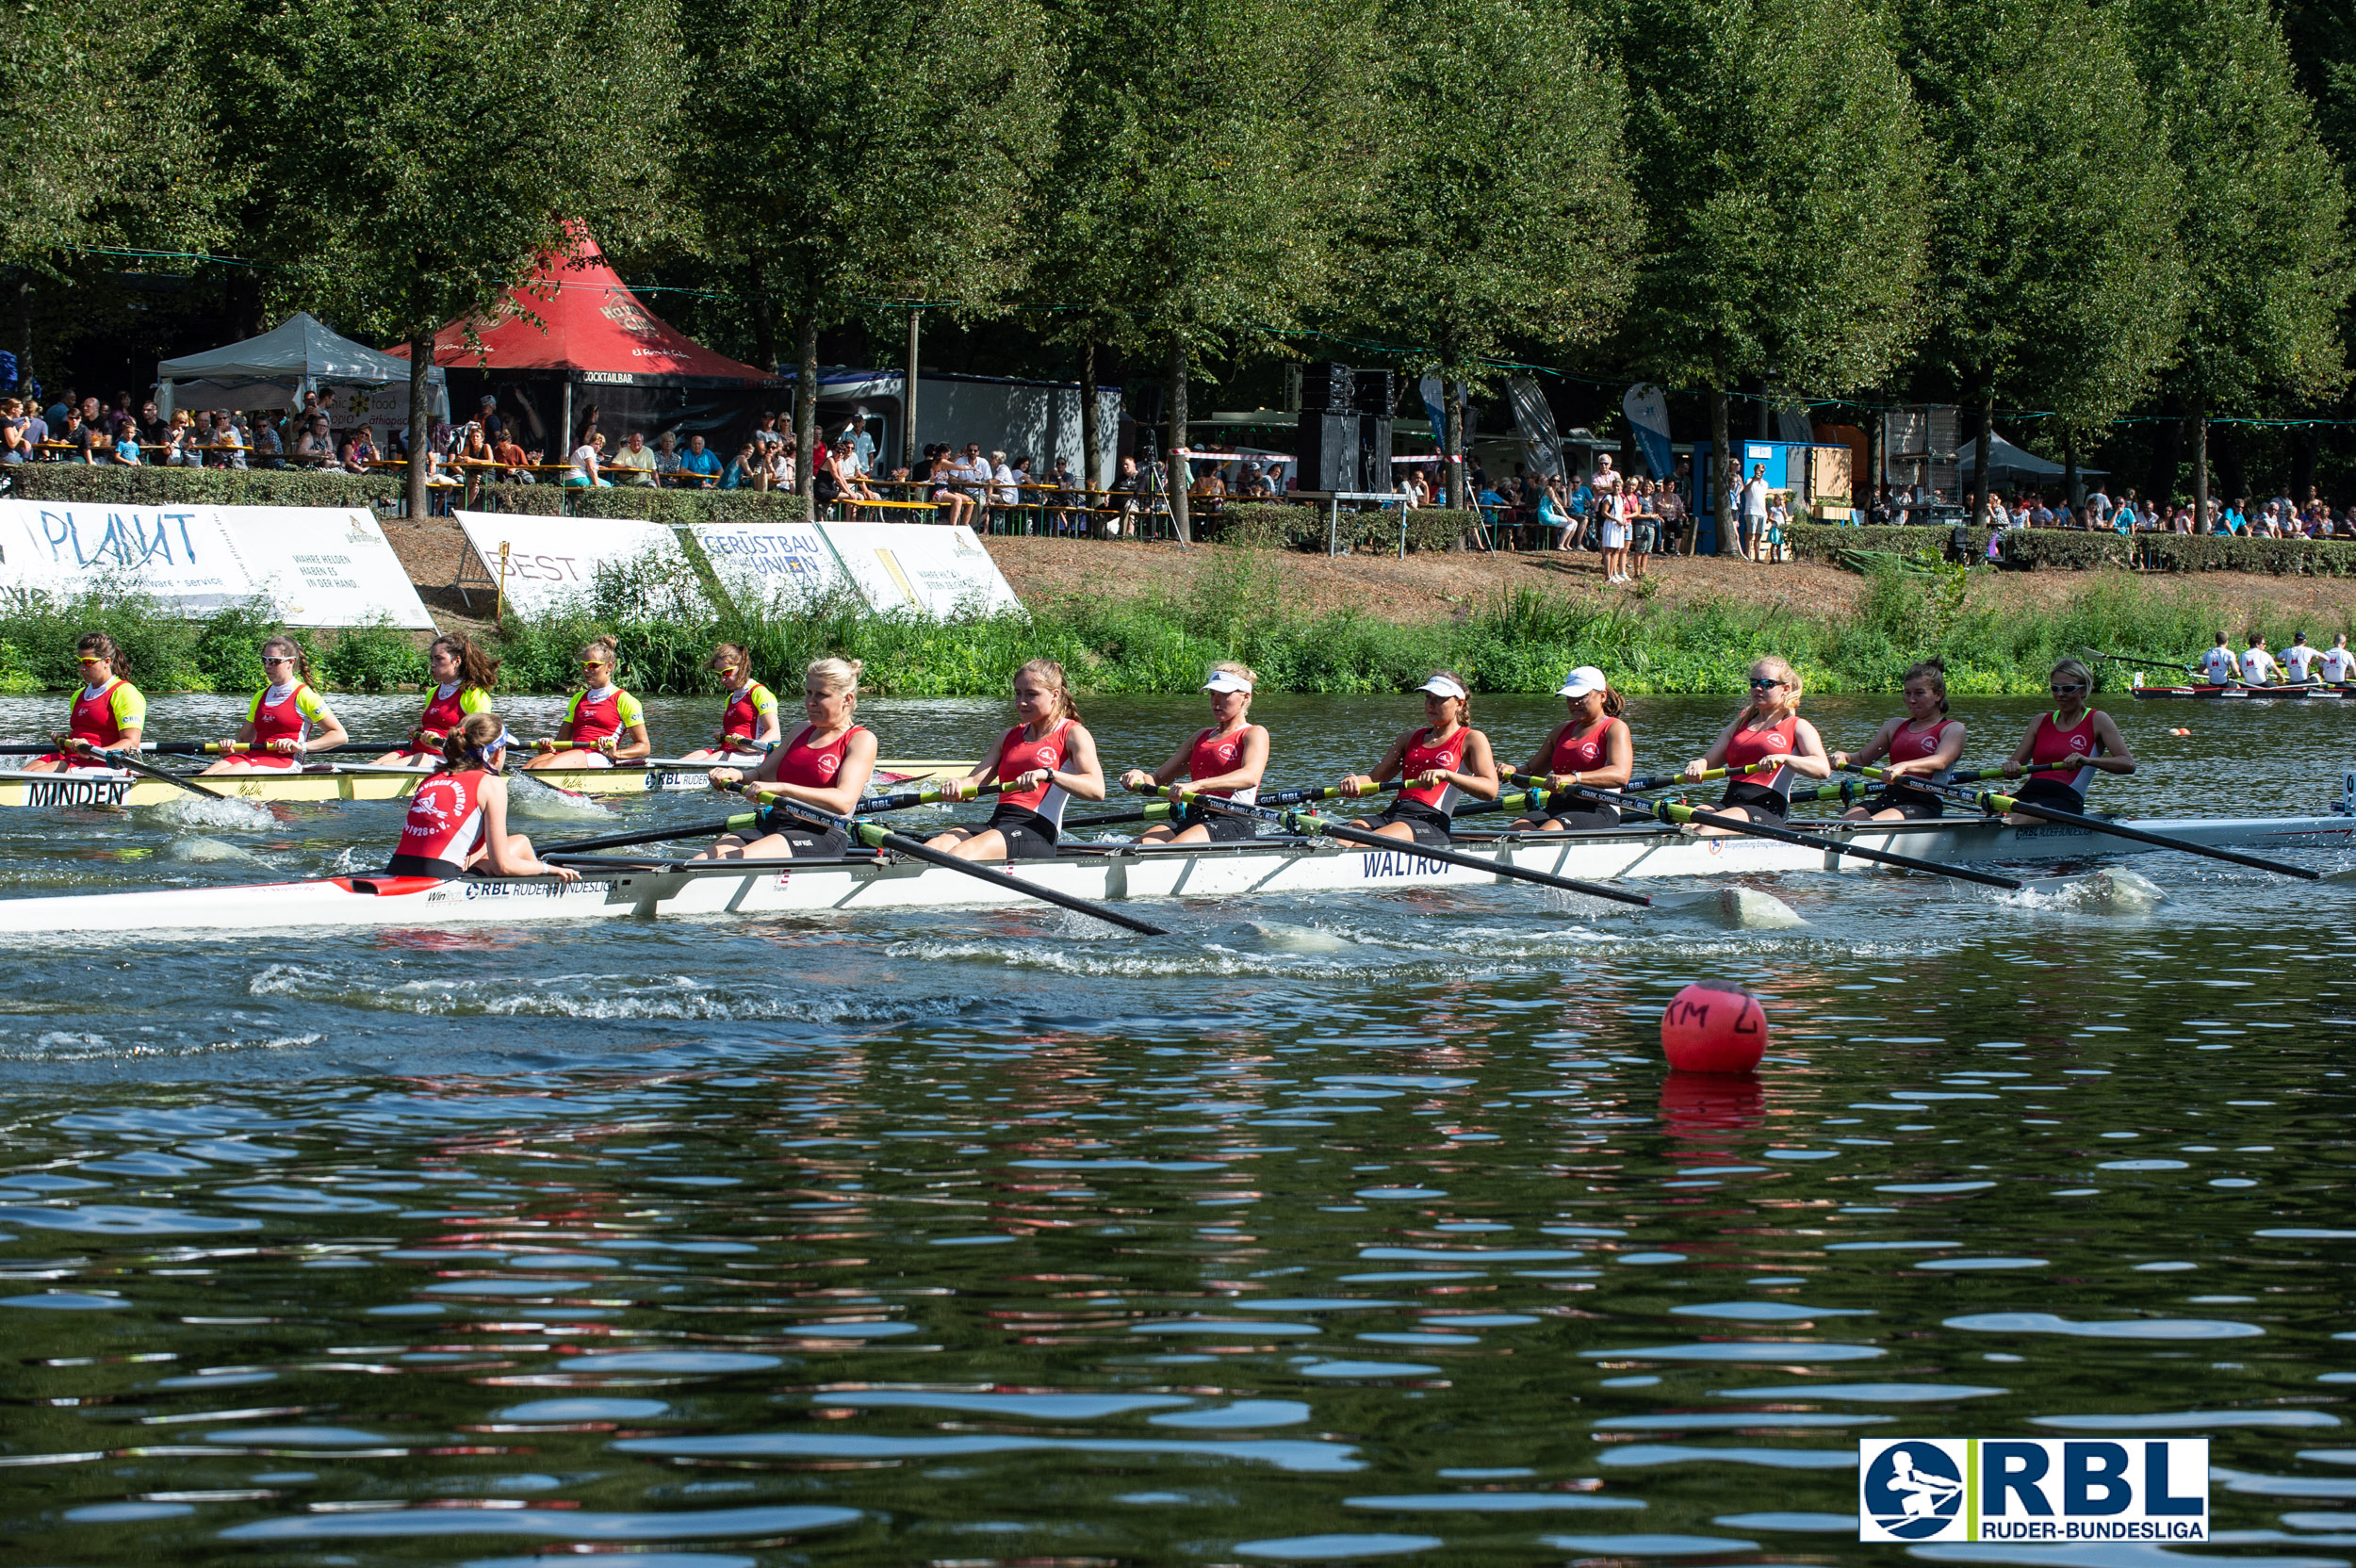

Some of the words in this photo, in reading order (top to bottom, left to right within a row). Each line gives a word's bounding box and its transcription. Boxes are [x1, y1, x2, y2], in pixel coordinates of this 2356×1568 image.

[632, 348, 642, 356] El
[643, 348, 662, 356] Ron
[583, 371, 633, 384] COCKTAILBAR
[371, 396, 396, 410] food
[368, 414, 409, 428] äthiopisc
[41, 510, 196, 571] PLANAT
[292, 554, 321, 564] WAHRE
[323, 554, 352, 564] HELDEN
[299, 566, 326, 576] HABEN
[328, 567, 337, 577] ES
[484, 550, 580, 582] BEST
[184, 577, 223, 587] service
[306, 579, 317, 588] IN
[319, 579, 333, 588] DER
[335, 580, 360, 589] HAND.
[658, 773, 680, 785] RBL
[1628, 781, 1646, 790] RBL
[28, 782, 124, 807] MINDEN
[1260, 795, 1277, 804] GUT.
[1282, 792, 1300, 801] RBL
[1961, 792, 1974, 801] RBL
[871, 799, 891, 808] RBL
[1636, 802, 1650, 810] RBL
[1265, 811, 1279, 822] RBL
[481, 882, 510, 895] RBL
[514, 879, 617, 896] RUDER-BUNDESLIGA
